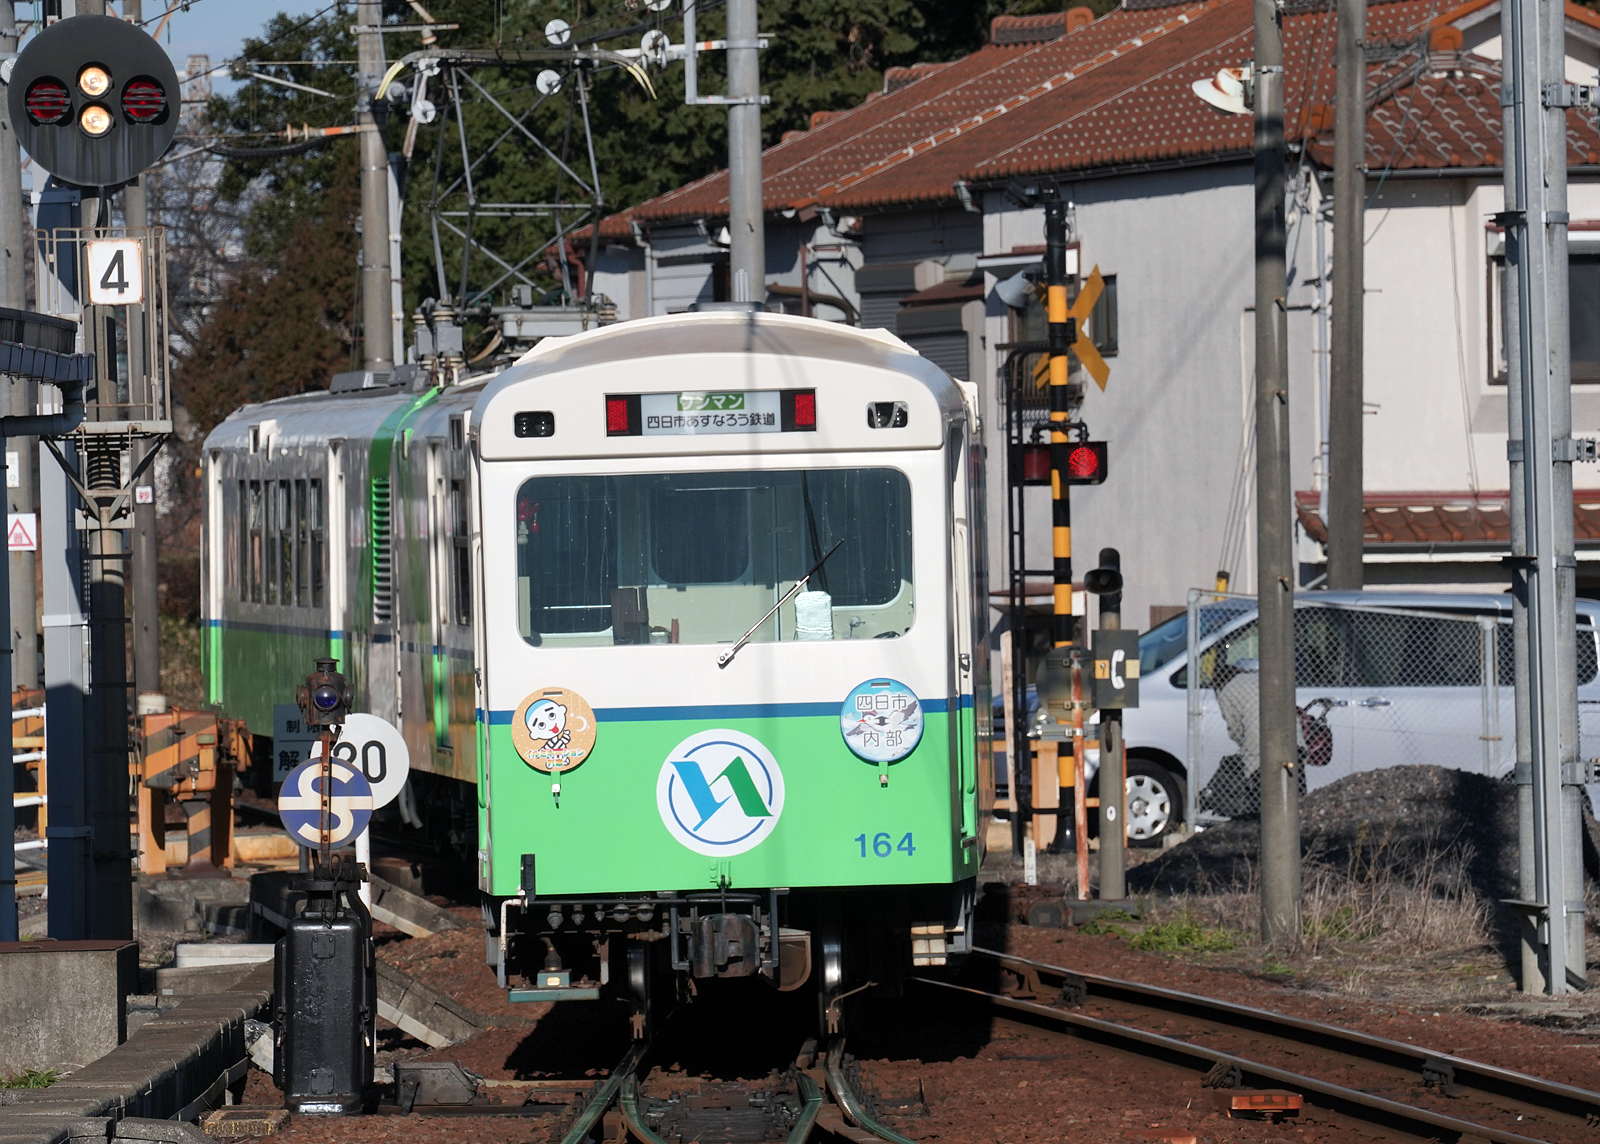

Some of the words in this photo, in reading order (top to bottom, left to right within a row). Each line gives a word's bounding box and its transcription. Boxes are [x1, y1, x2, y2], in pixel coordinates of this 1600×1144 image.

[100, 249, 129, 294] 4
[679, 394, 743, 410] ワンマン
[647, 412, 775, 429] 四日市あすなろう鉄道
[856, 693, 907, 710] 四日市
[863, 730, 903, 747] 内部
[854, 832, 916, 858] 164
